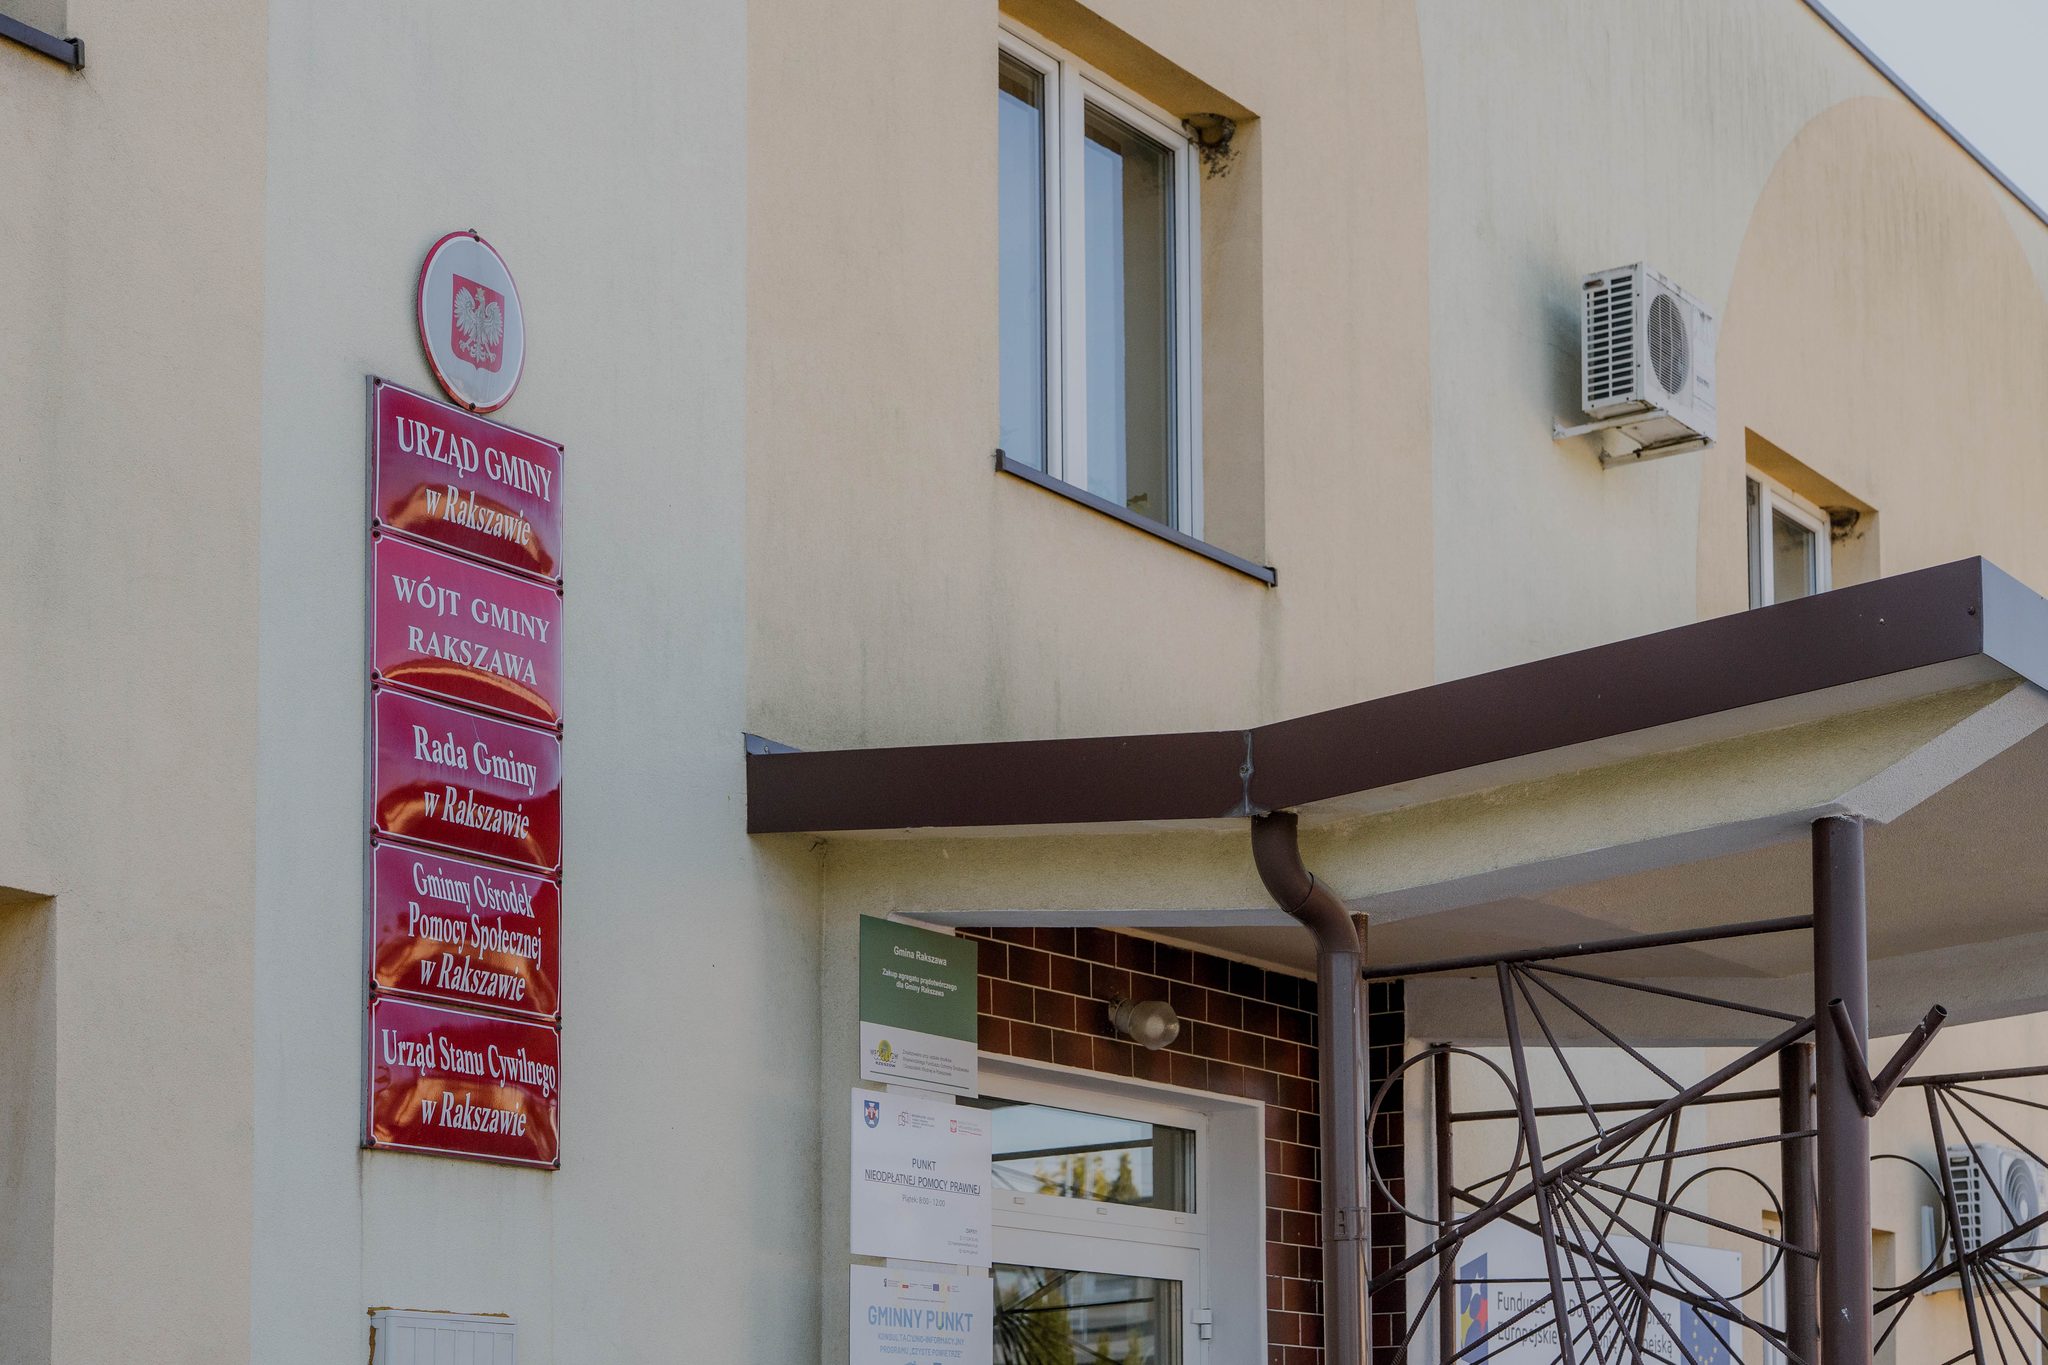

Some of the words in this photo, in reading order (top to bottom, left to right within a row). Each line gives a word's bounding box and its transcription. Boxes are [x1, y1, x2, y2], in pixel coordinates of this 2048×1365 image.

[396, 416, 479, 478] URZĄD
[485, 447, 552, 502] GMINY
[426, 488, 441, 516] w
[443, 485, 531, 545] Rakszawie
[392, 575, 461, 617] WÓJT
[471, 598, 550, 644] GMINY
[408, 625, 537, 686] RAKSZAWA
[412, 724, 468, 771] Rada
[473, 741, 537, 795] Gminy
[424, 791, 440, 818] w
[441, 785, 530, 840] Rakszawie
[413, 861, 470, 913] Gminny
[473, 875, 535, 919] Ośrodek
[408, 901, 467, 954] Pomocy
[471, 913, 542, 971] Społecznej
[893, 945, 915, 959] Gmina
[915, 951, 947, 966] Rakszawa
[420, 959, 437, 986] w
[437, 952, 526, 1002] Rakszawie
[882, 968, 898, 979] Zakup
[904, 982, 920, 993] Gminy
[382, 1029, 436, 1076] Urząd
[439, 1036, 485, 1077] Stanu
[488, 1045, 556, 1098] Cywilnego
[421, 1099, 438, 1125] w
[439, 1091, 527, 1137] Rakszawie
[865, 1169, 916, 1186] NIEODPŁATNEJ
[918, 1177, 947, 1191] POMOCY
[950, 1181, 981, 1195] PRAWNEJ
[912, 1158, 936, 1171] PUNKT
[868, 1305, 922, 1329] GMINNY
[926, 1310, 973, 1332] PUNKT
